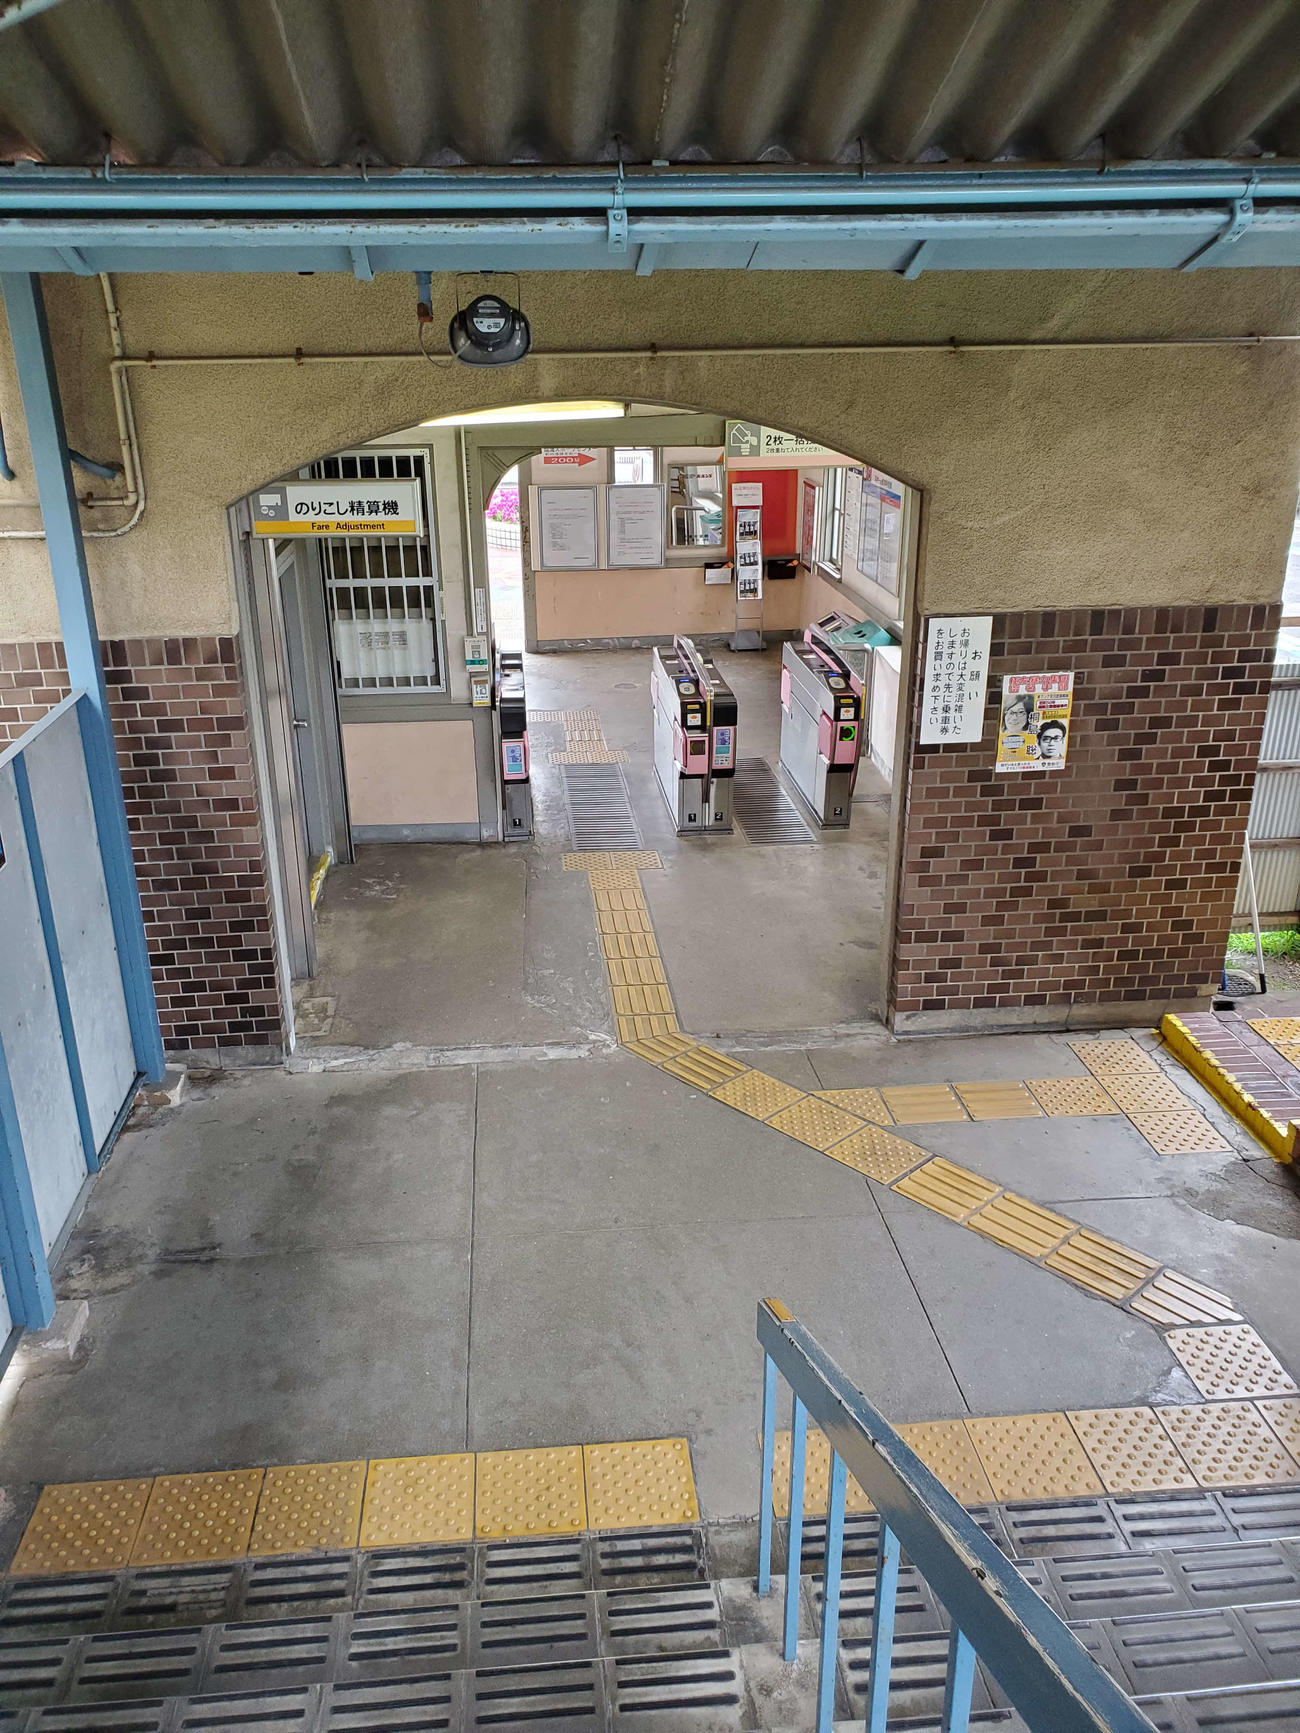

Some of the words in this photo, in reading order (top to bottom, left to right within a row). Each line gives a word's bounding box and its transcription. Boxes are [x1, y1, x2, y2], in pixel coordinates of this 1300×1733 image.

[294, 499, 400, 517] のりこし精算機
[311, 521, 330, 531] Fare
[335, 521, 386, 532] Adjustment
[929, 627, 945, 725] をお買い求め下さい
[939, 627, 958, 736] しますので先に乗車券
[952, 627, 971, 735] お帰りは大変混雑いた
[968, 649, 982, 701] お願い
